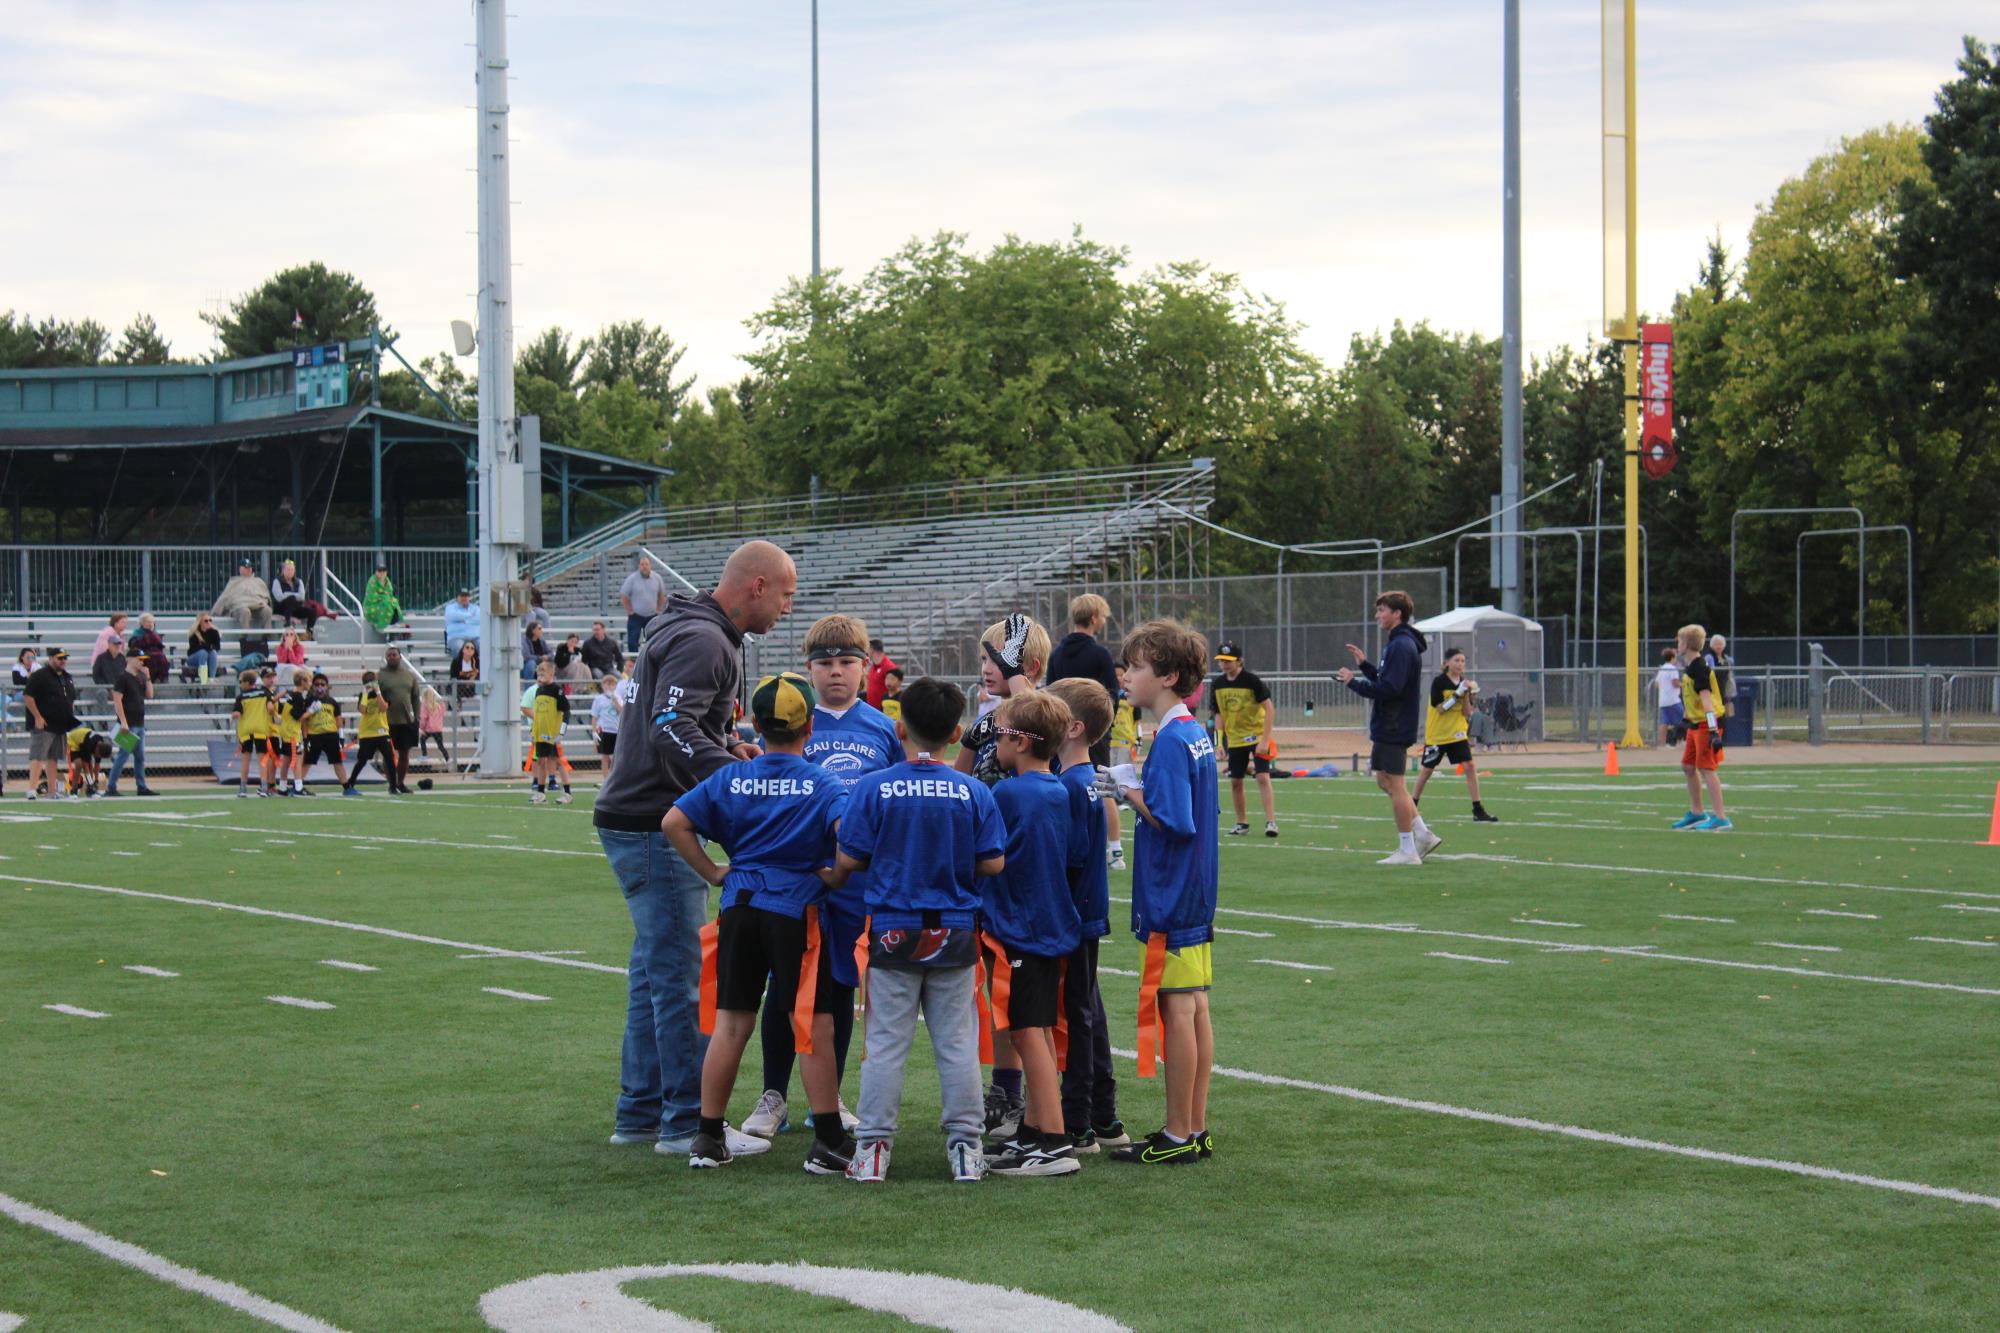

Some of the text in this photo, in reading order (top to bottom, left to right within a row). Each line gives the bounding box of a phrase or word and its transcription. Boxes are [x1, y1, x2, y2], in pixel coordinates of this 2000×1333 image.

[804, 741, 877, 760] EAU CLAIRE
[730, 777, 815, 796] SCHEELS
[880, 779, 971, 801] SCHEELS
